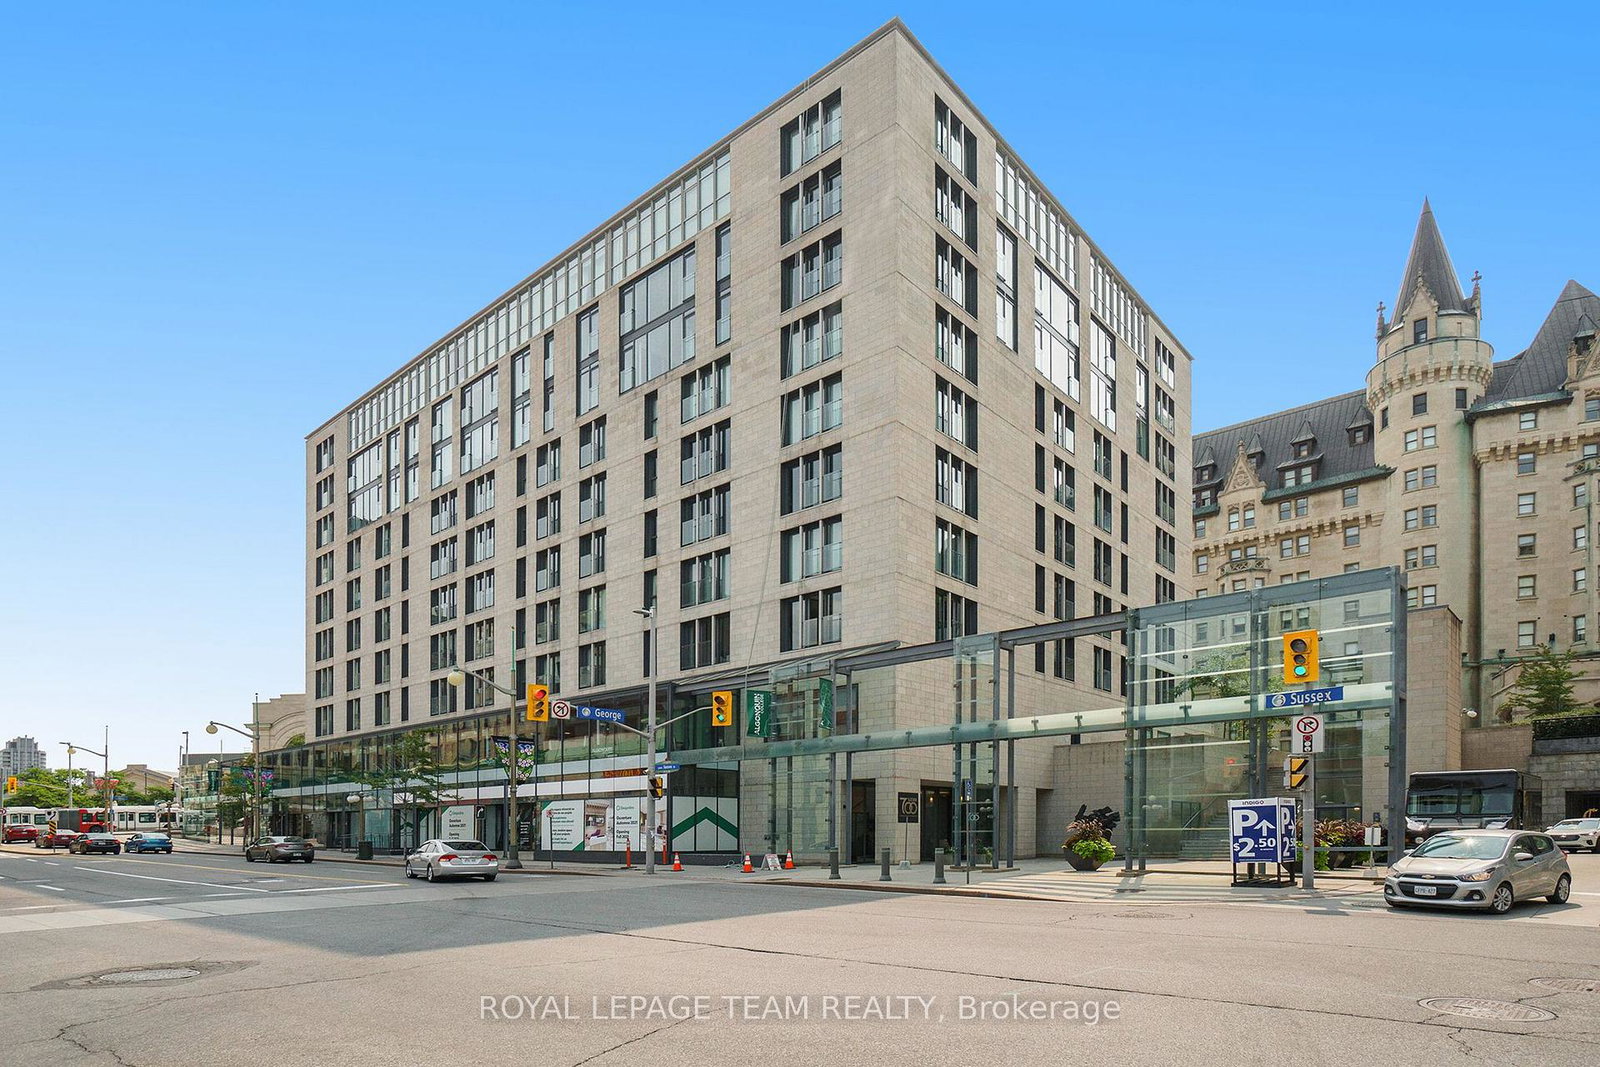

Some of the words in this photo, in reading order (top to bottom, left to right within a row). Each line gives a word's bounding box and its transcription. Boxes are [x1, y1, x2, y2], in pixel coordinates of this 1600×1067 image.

[1290, 690, 1332, 705] Sussex
[594, 708, 622, 721] George
[1233, 809, 1258, 837] P
[1281, 807, 1290, 834] P
[1234, 837, 1276, 857] $2.50
